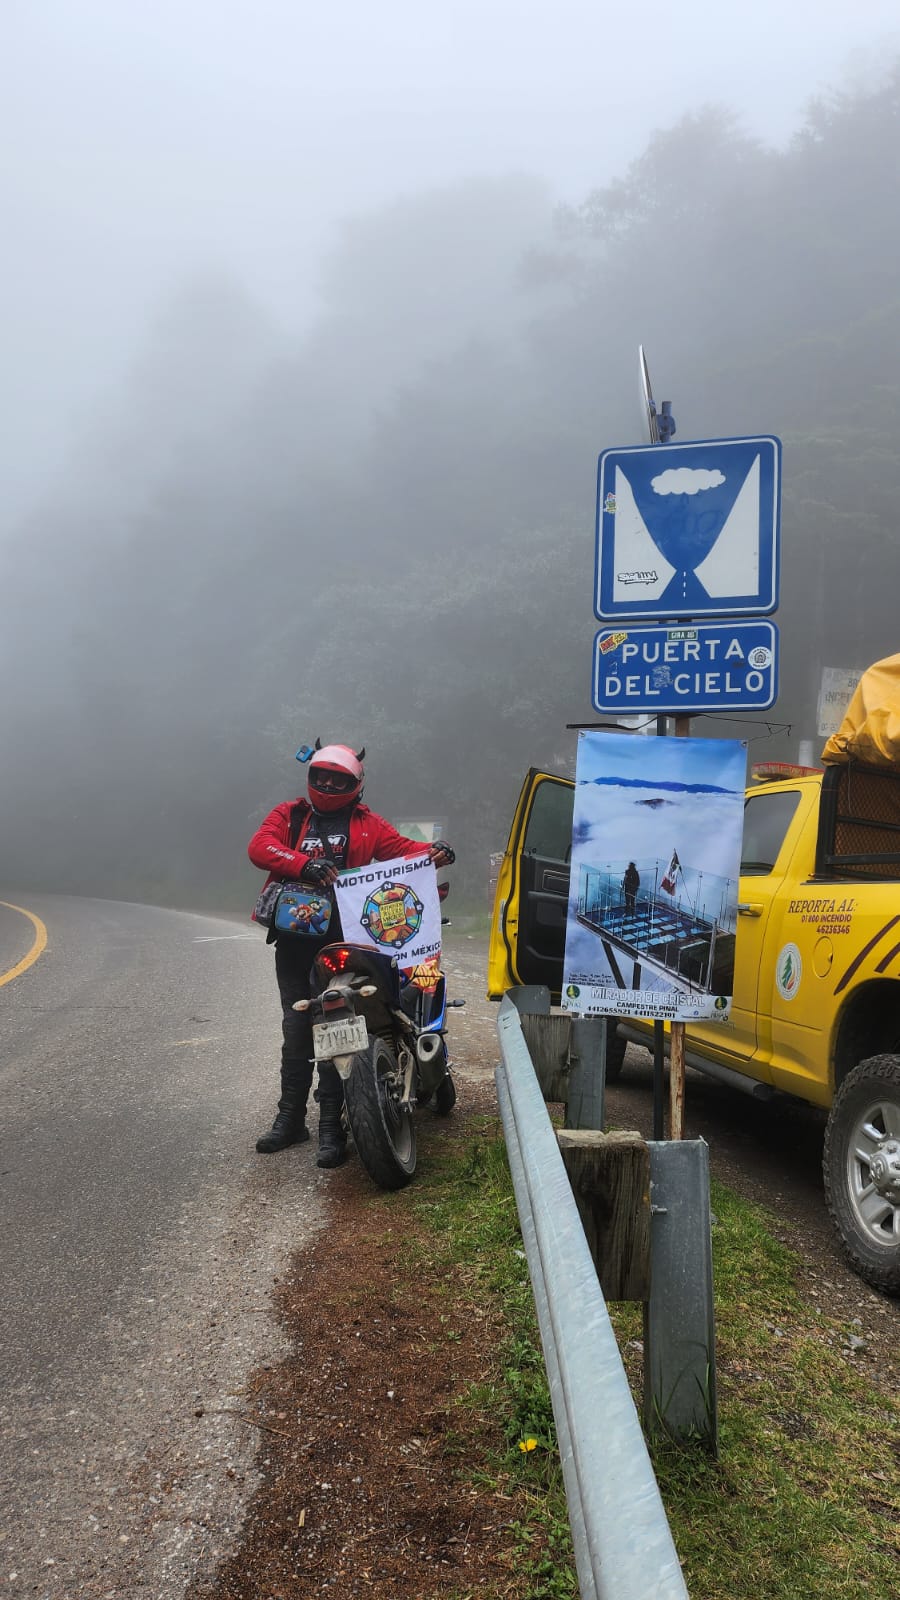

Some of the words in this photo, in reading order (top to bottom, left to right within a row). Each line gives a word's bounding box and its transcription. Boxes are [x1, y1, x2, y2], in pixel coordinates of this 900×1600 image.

[622, 638, 745, 664] PUERTA
[605, 675, 661, 697] DEL
[673, 671, 764, 695] CIELO
[336, 857, 432, 889] MOTOTURISMO
[788, 899, 836, 914] REPORTA
[820, 914, 853, 923] INCENDIO
[591, 986, 643, 1005] MIRADOR
[645, 992, 660, 1005] DE
[662, 994, 705, 1009] CRISTAL
[616, 1001, 658, 1011] CAMPESTRE
[659, 1005, 680, 1013] PINAL
